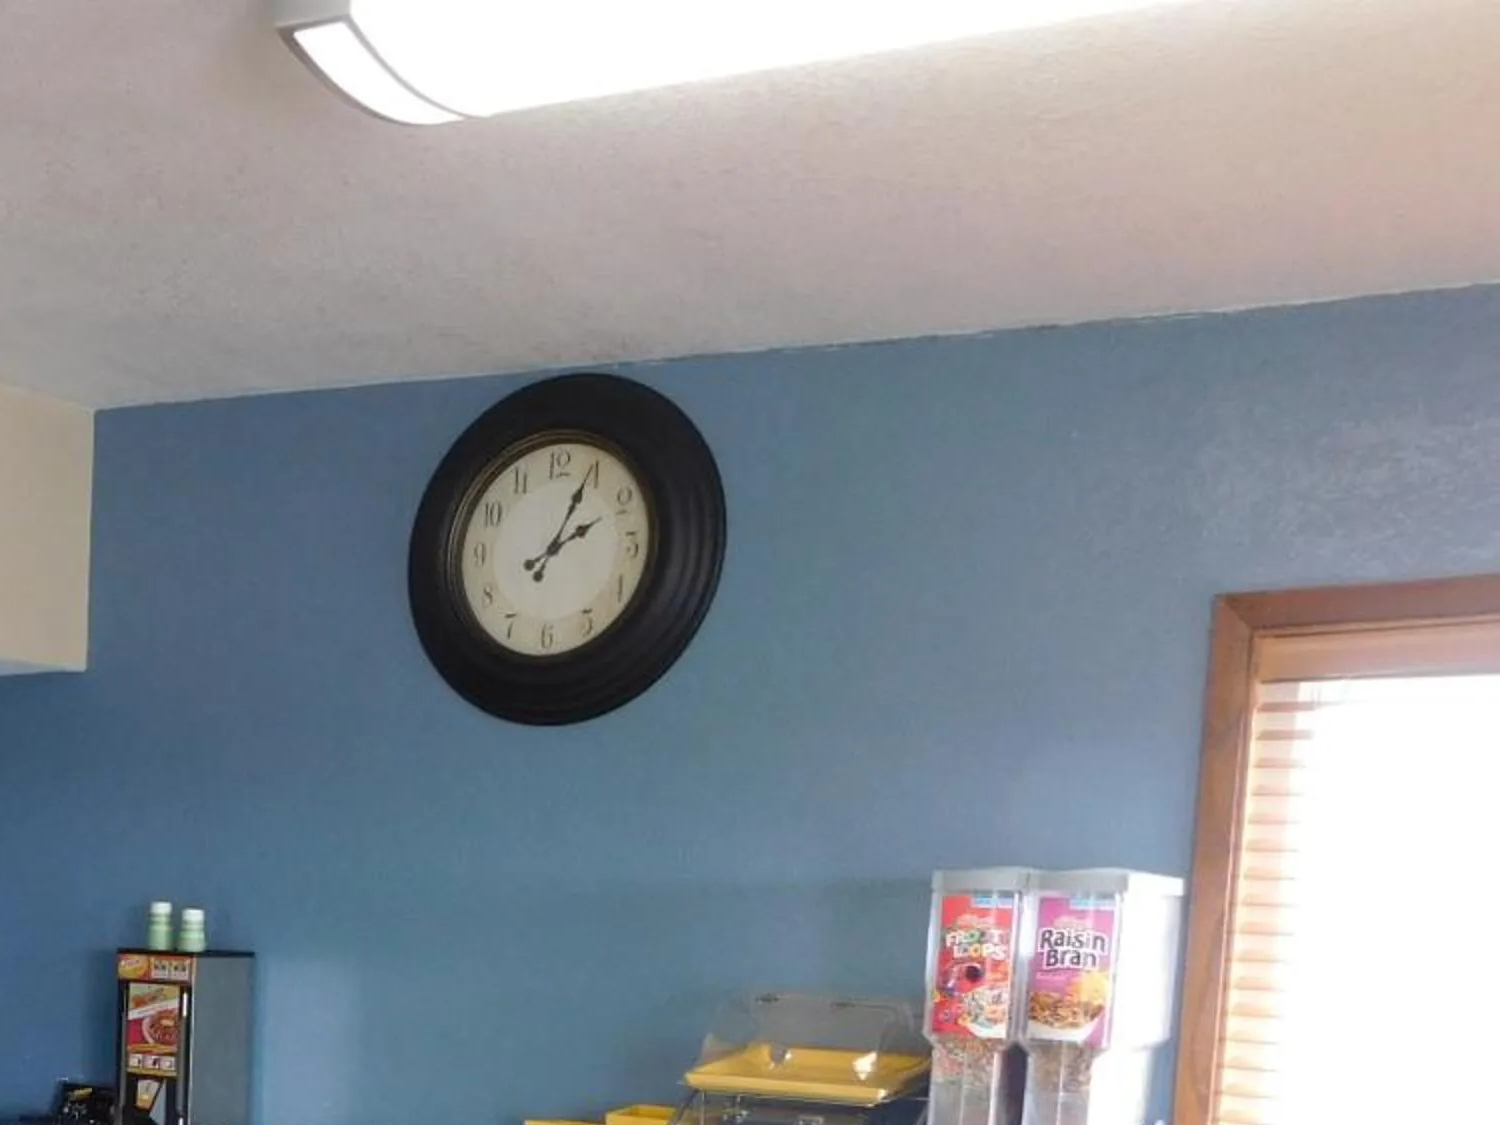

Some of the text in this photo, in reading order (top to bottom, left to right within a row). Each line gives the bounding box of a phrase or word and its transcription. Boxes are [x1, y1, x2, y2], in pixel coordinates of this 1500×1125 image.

[549, 450, 571, 480] 12
[513, 465, 528, 494] 11
[616, 486, 633, 516] 2
[485, 502, 502, 527] 10
[473, 542, 487, 567] 9
[625, 530, 639, 559] 3
[482, 583, 494, 607] 8
[503, 612, 518, 640] 7
[541, 623, 555, 649] 6
[1038, 928, 1107, 953] Raisin
[1044, 948, 1098, 968] Bran
